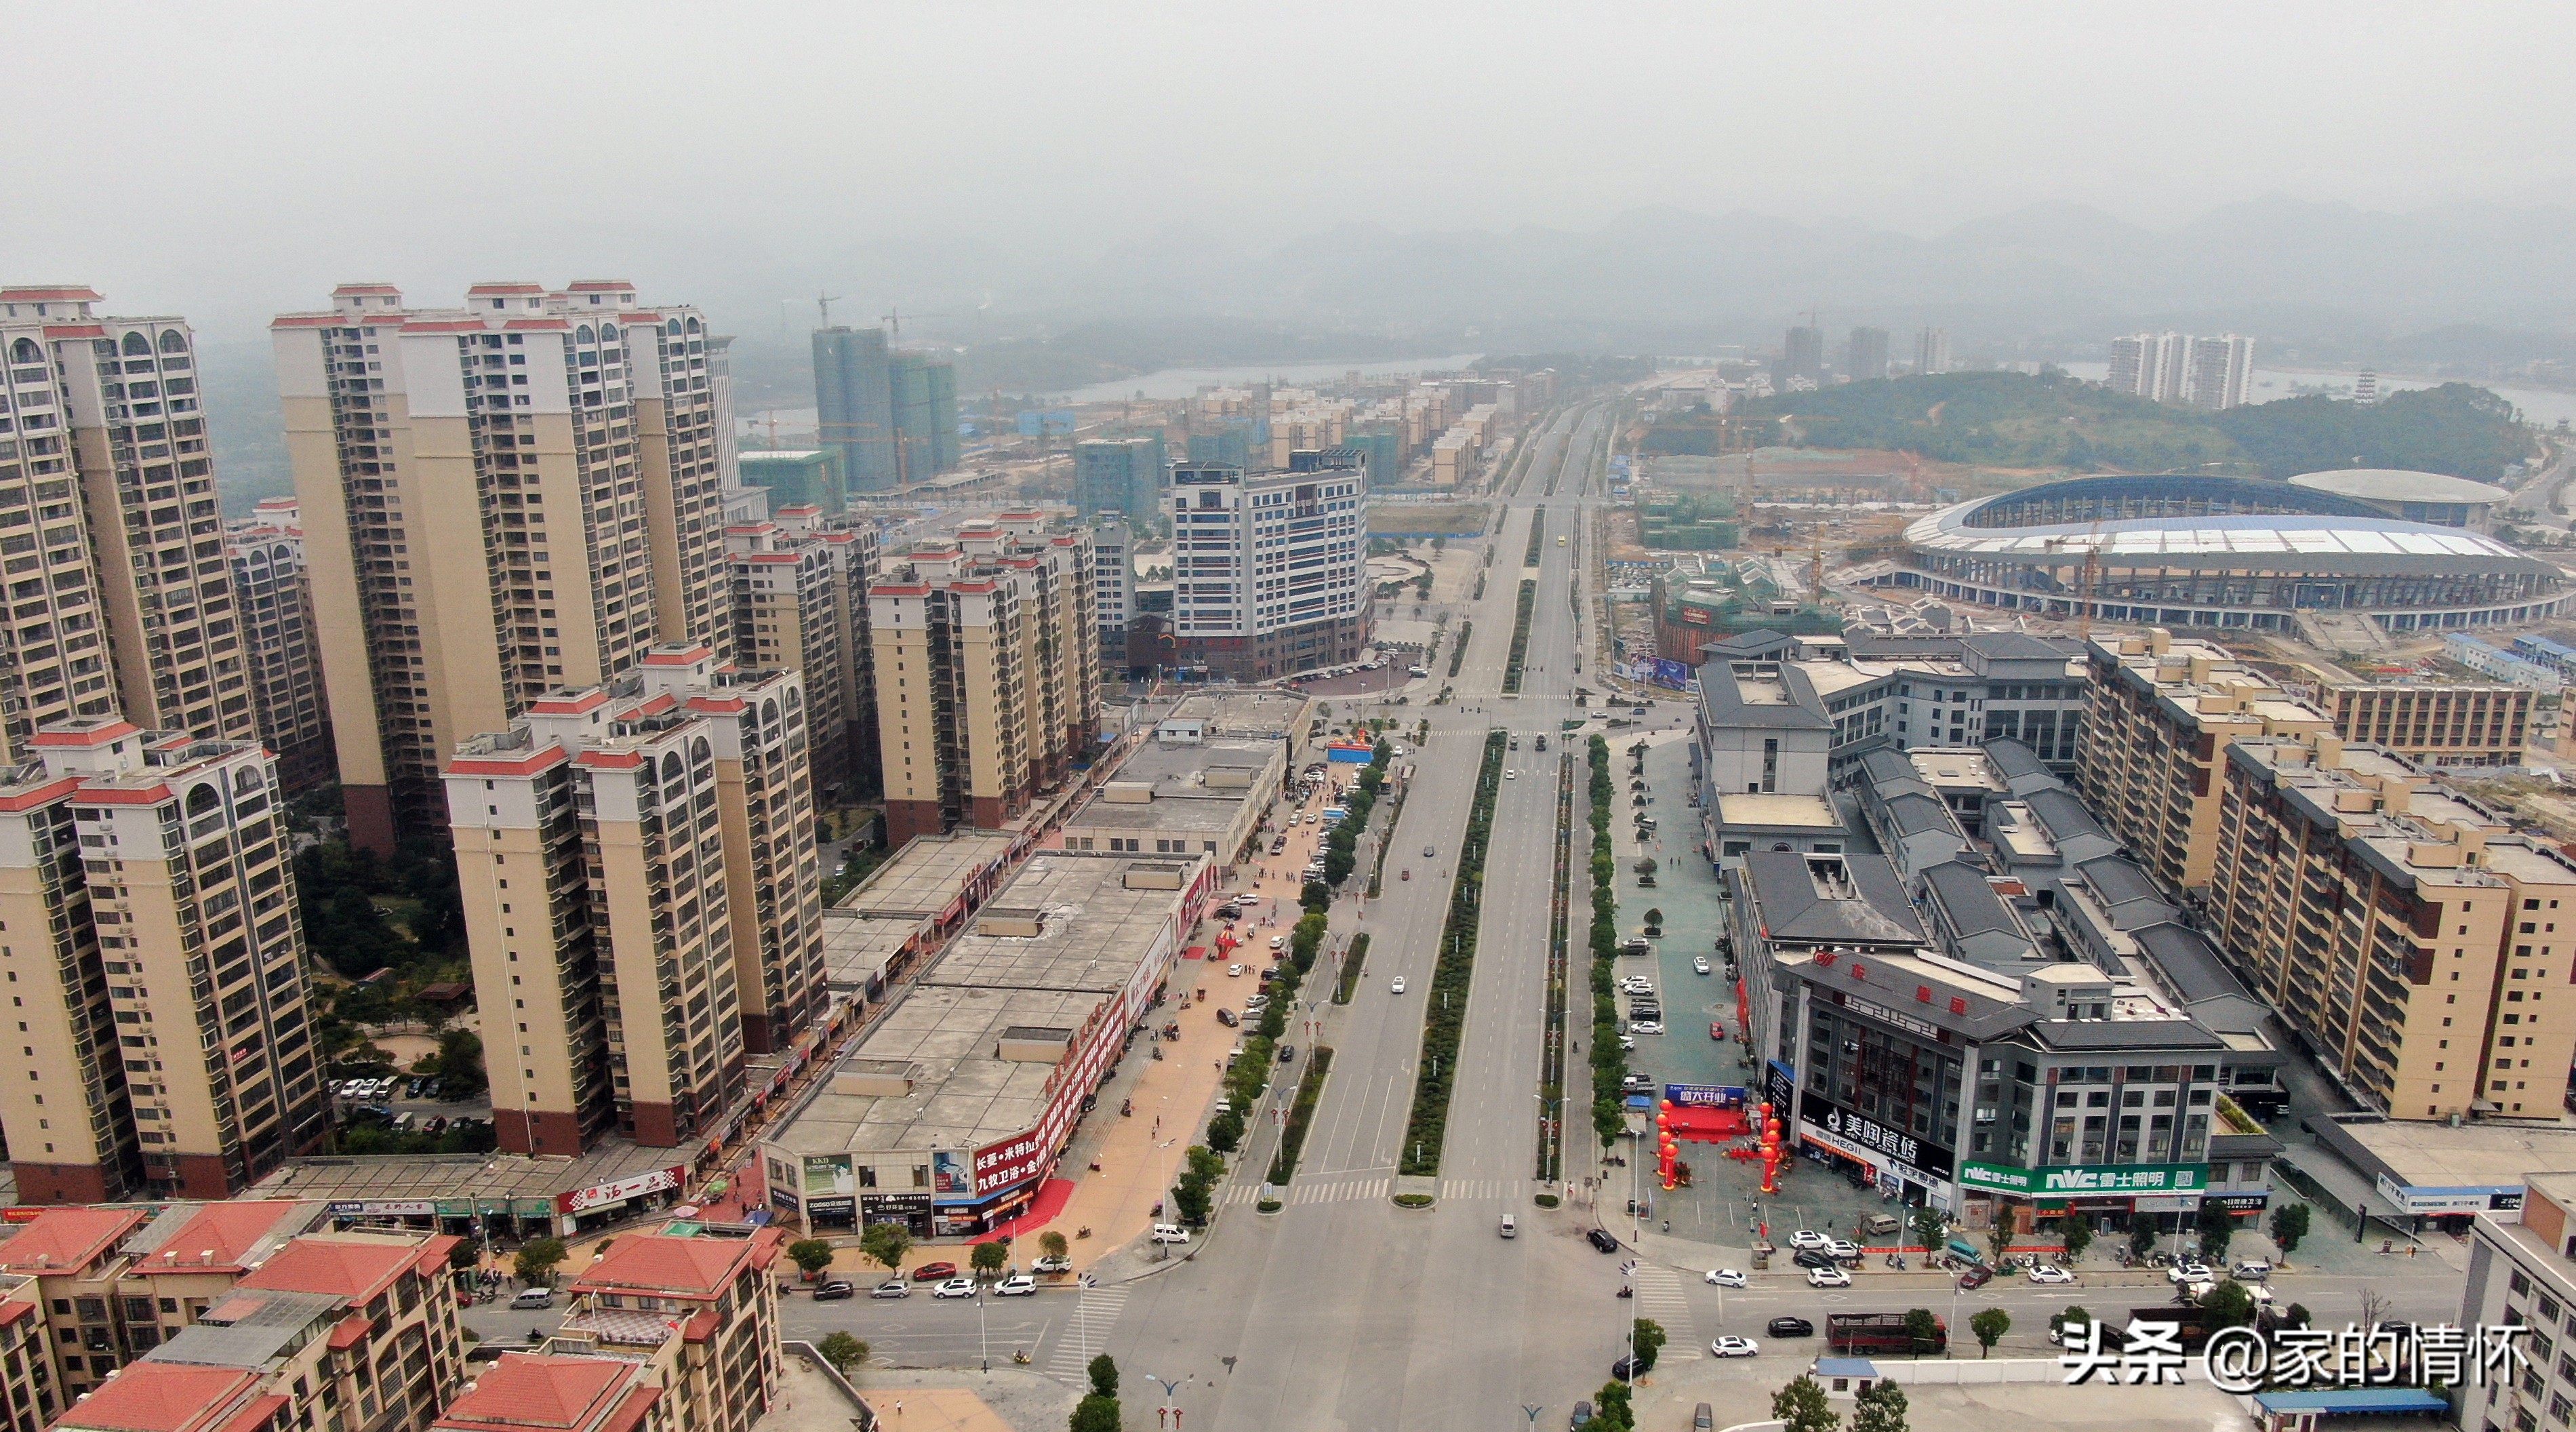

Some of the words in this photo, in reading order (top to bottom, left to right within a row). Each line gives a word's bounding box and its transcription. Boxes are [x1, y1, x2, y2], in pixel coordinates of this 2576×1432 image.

[1832, 1135, 1861, 1155] HEGII
[1845, 1130, 1857, 1140] MEI
[1861, 1137, 1874, 1147] TAO
[1846, 1113, 1918, 1160] 美陶瓷砖
[2100, 1172, 2165, 1187] 雷士照明
